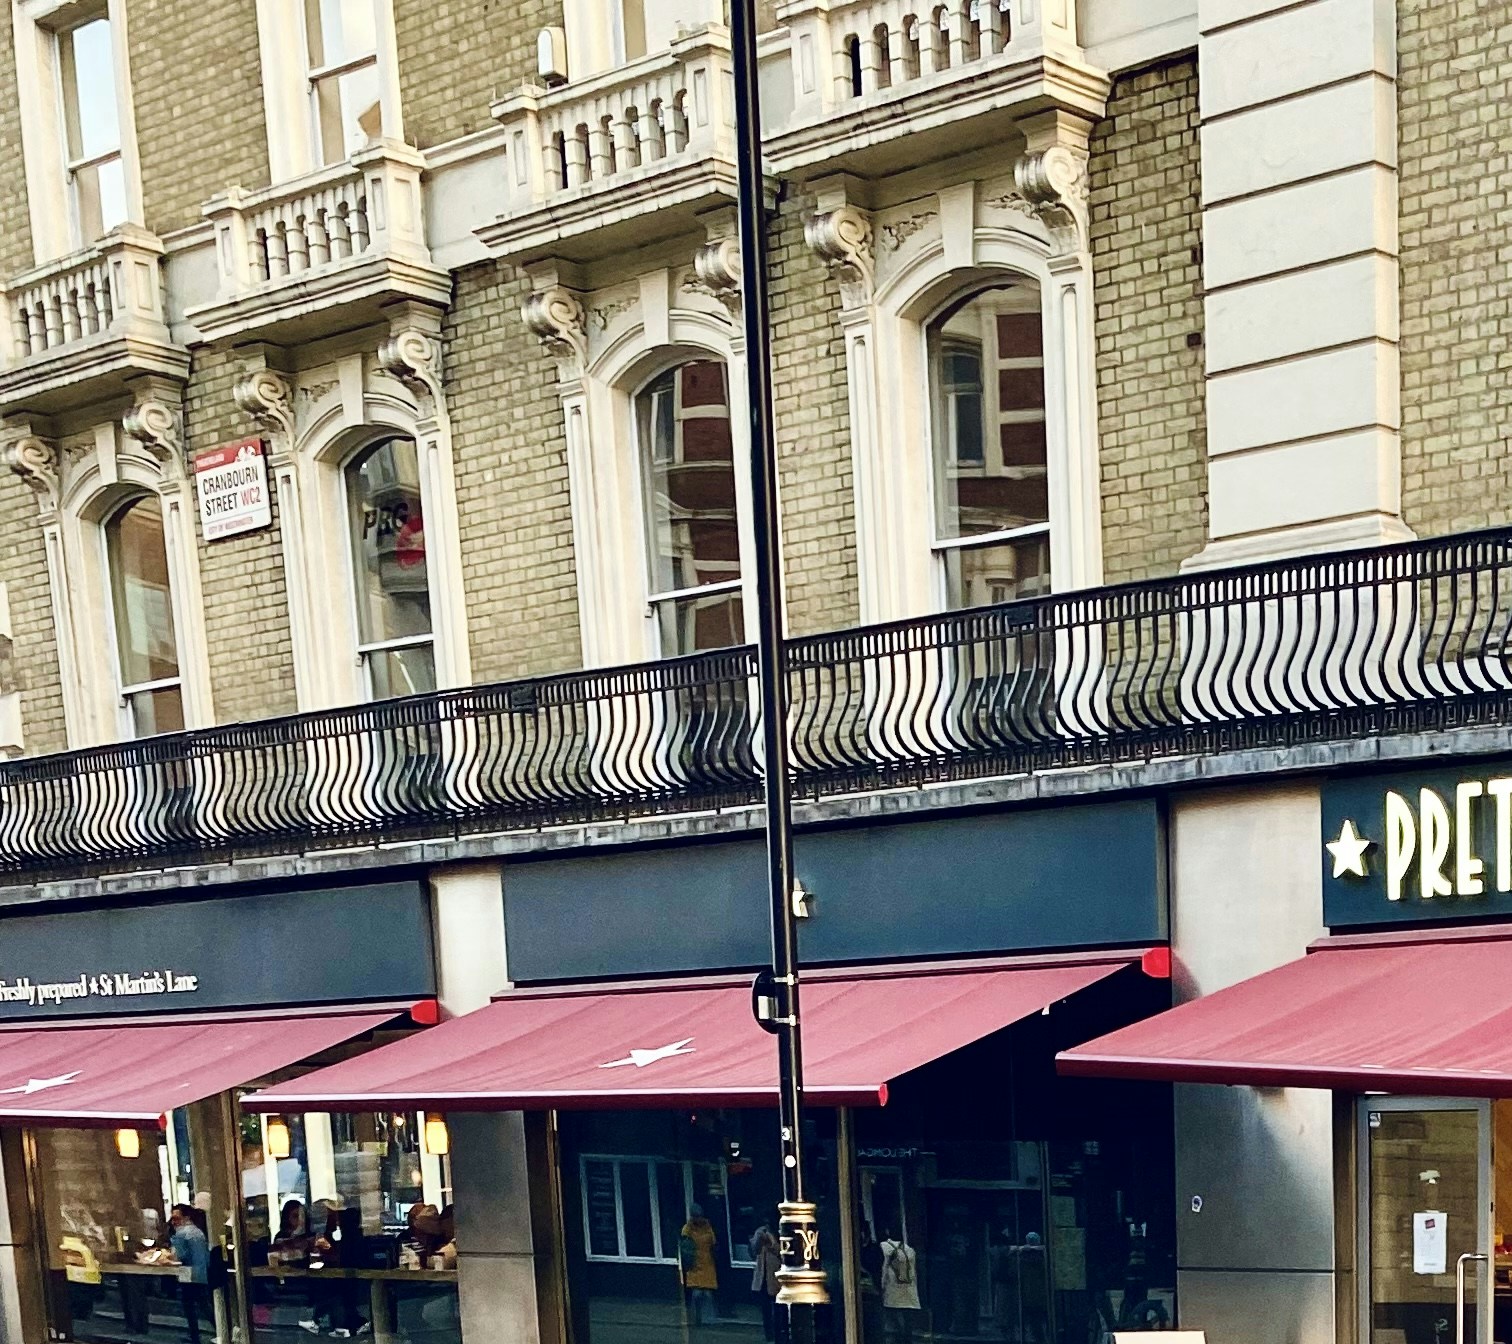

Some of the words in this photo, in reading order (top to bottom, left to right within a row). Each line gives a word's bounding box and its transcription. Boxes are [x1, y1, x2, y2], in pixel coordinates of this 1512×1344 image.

[203, 465, 259, 495] CRANBOURN
[205, 492, 238, 516] STREET
[240, 486, 261, 507] WC2
[37, 973, 88, 1005] prepared
[100, 974, 114, 996] St
[114, 971, 165, 995] Martin's
[165, 970, 198, 992] Lane
